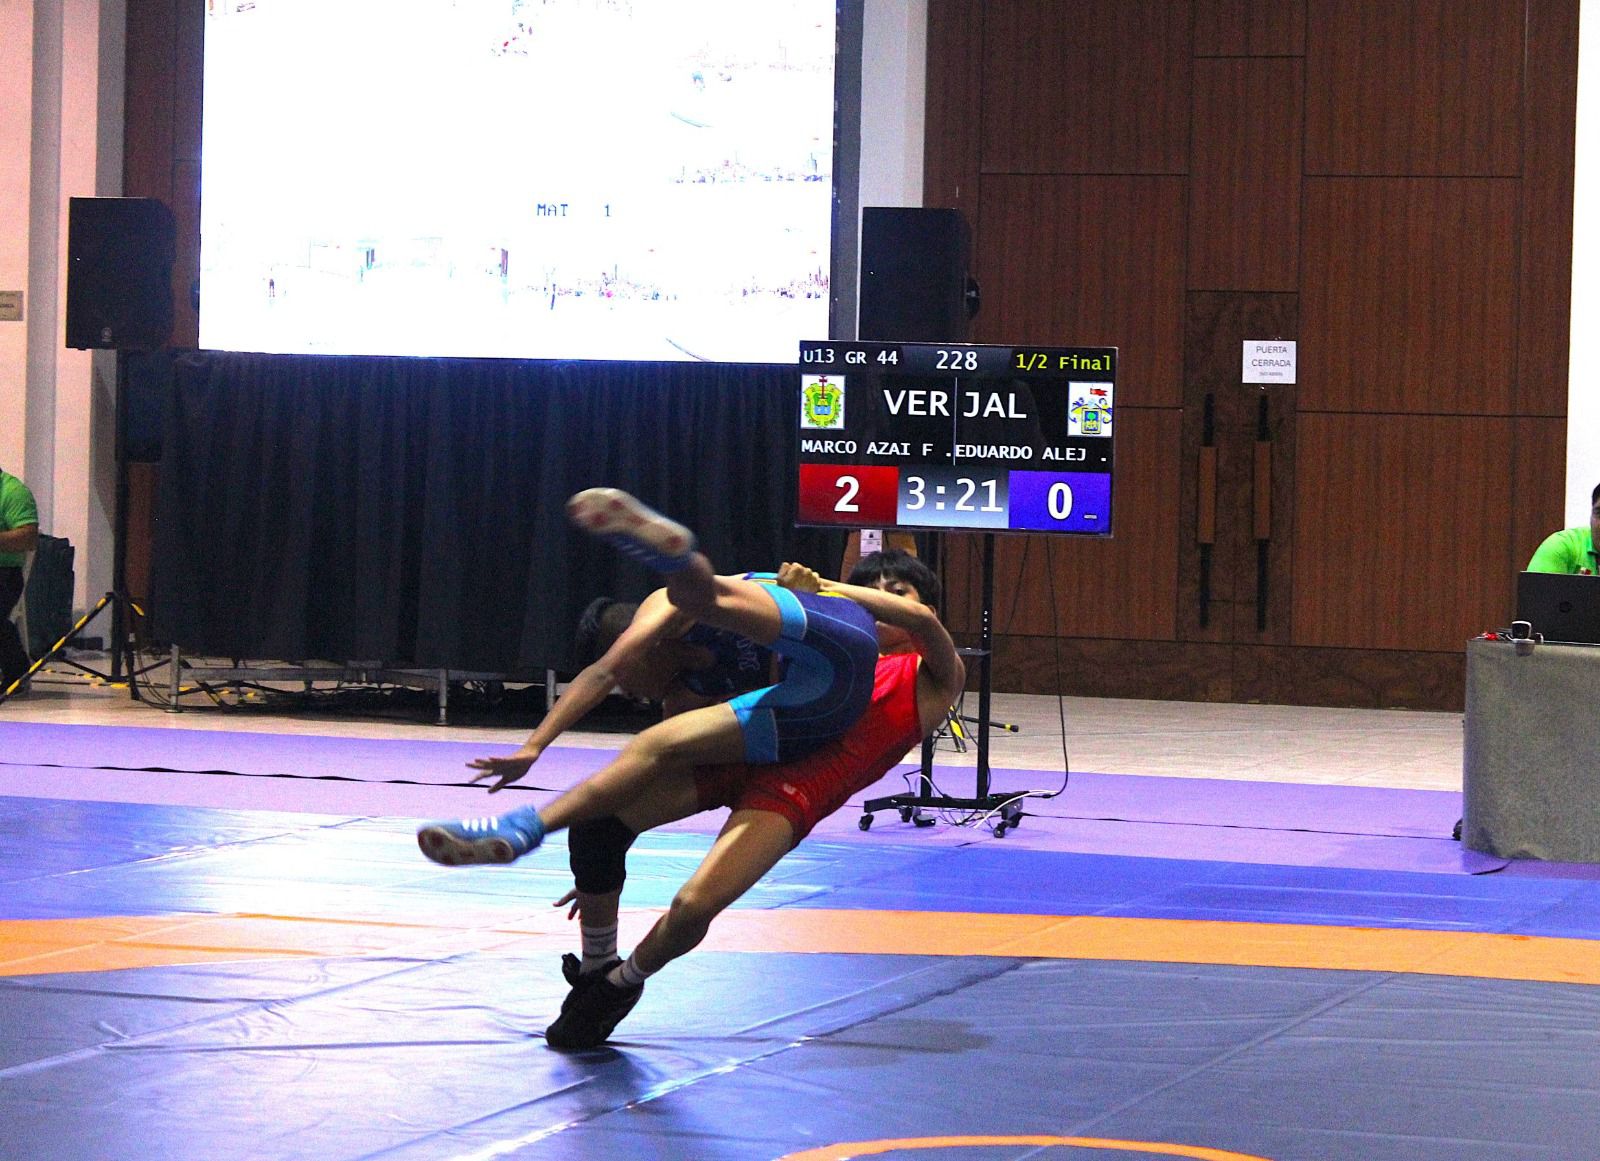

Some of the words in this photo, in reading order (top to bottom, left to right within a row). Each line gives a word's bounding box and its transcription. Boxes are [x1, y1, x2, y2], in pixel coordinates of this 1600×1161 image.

[536, 203, 568, 216] MAT
[604, 203, 610, 217] 1
[803, 349, 835, 363] U13
[845, 351, 867, 364] GR
[877, 351, 898, 364] 44
[936, 350, 978, 370] 228
[1016, 354, 1047, 370] 1/2
[1059, 355, 1111, 370] Final
[1252, 359, 1291, 367] CERRADA
[884, 390, 950, 416] VER
[963, 392, 1027, 418] JAL
[801, 440, 857, 454] MARCO
[866, 442, 911, 455] AZAI
[922, 444, 933, 455] F
[955, 445, 1032, 459] EDUARDO
[1041, 447, 1086, 461] ALEJ
[834, 476, 859, 512] 2
[906, 476, 1004, 512] 3:21
[1048, 482, 1073, 519] 0
